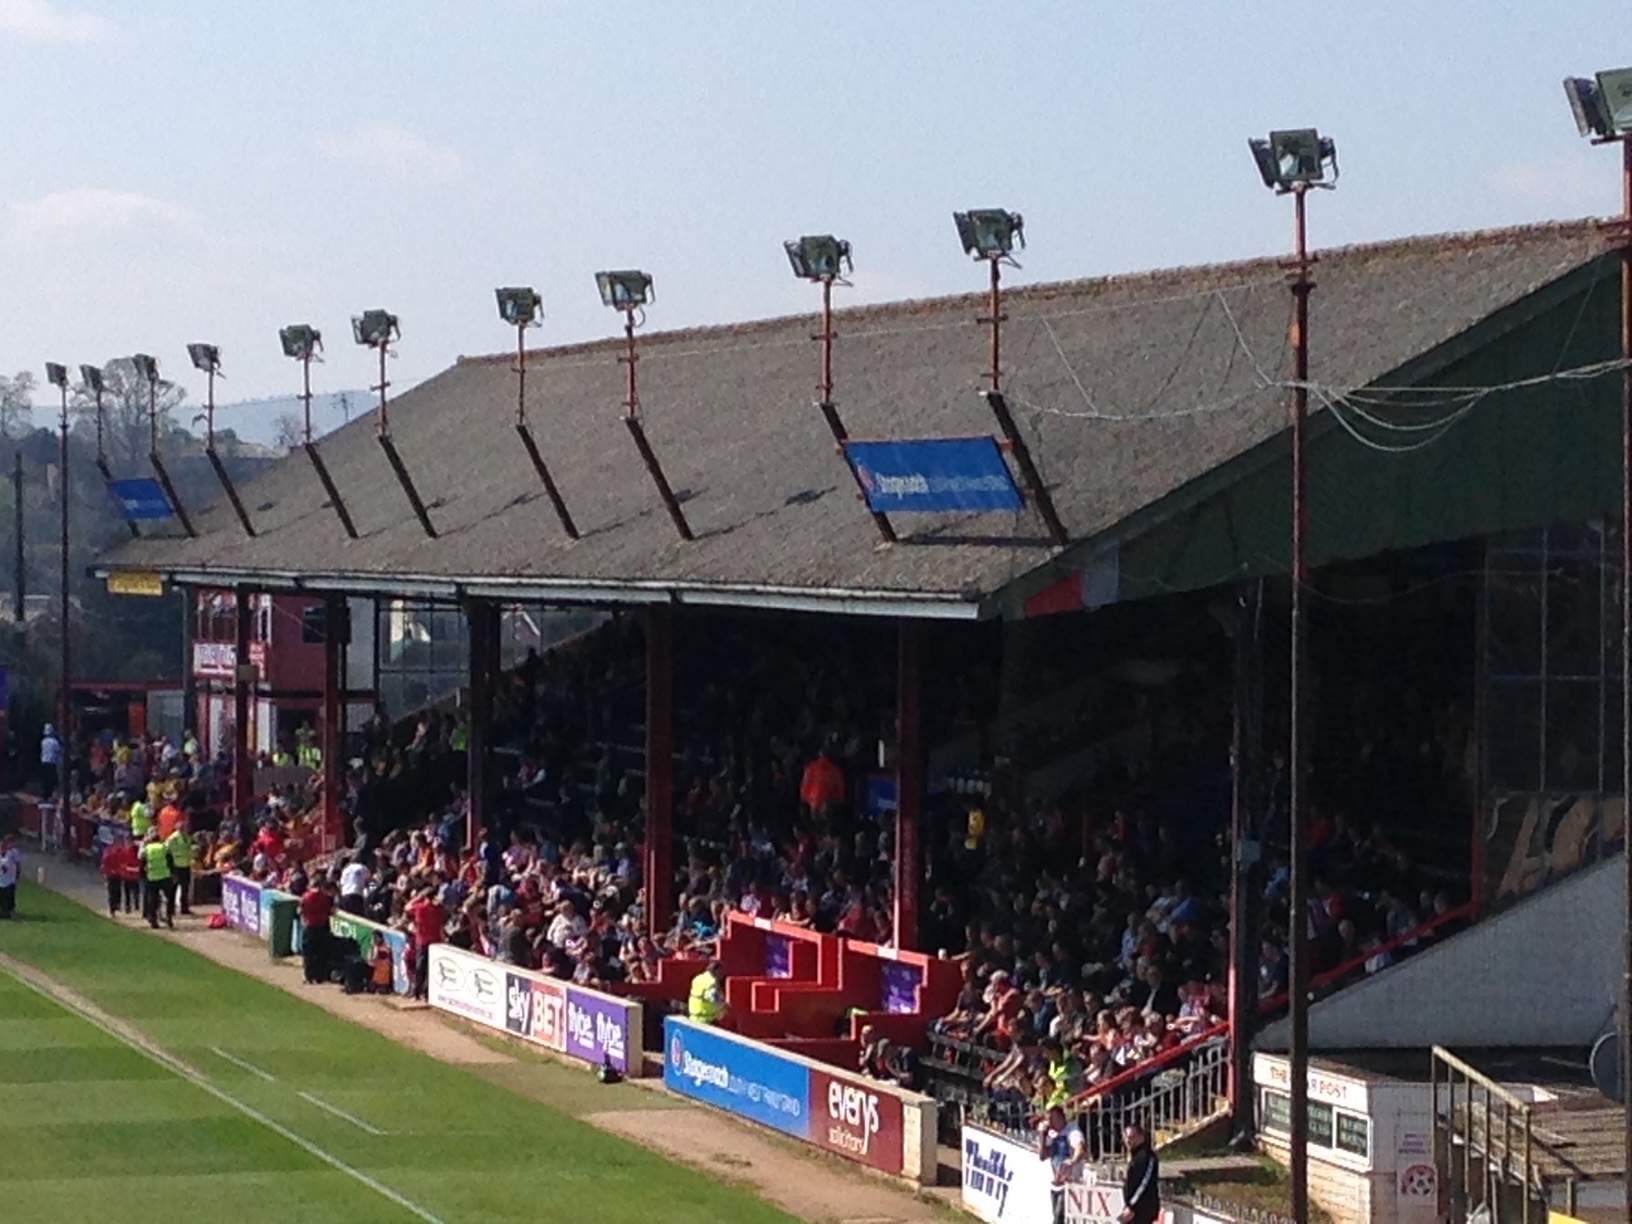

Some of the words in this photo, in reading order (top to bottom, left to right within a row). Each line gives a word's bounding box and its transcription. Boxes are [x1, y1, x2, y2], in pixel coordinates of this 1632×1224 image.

[508, 978, 530, 1033] sky
[533, 990, 563, 1048] BET
[1319, 1081, 1348, 1099] POST
